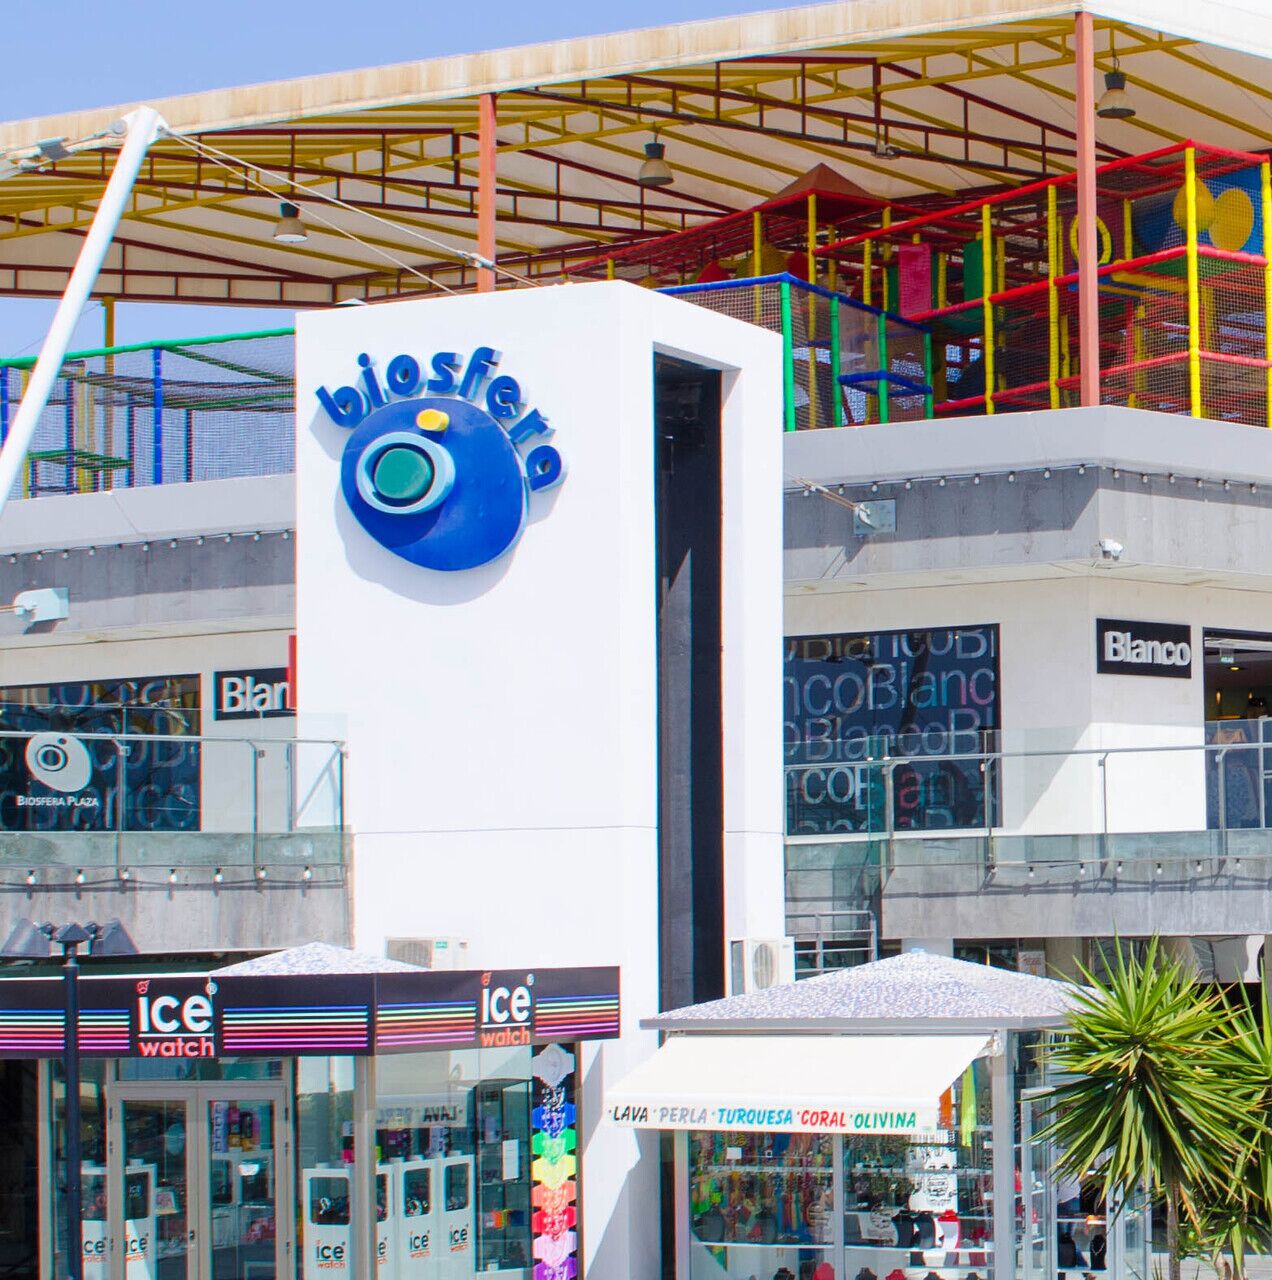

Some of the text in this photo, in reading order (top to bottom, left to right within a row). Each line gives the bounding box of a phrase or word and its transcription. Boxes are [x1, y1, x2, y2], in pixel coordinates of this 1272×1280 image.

[315, 346, 564, 492] biosfera
[1104, 630, 1192, 667] Blanco
[221, 676, 289, 713] Blan
[137, 980, 214, 1033] ice
[482, 972, 531, 1023] ice
[140, 1036, 215, 1057] watch
[481, 1026, 531, 1047] watch
[613, 1106, 916, 1129] LAVA PERLA TURQUESA CORAL OLIVINA
[408, 1231, 429, 1250] ice
[448, 1225, 468, 1244] ice
[316, 1239, 344, 1260] ice
